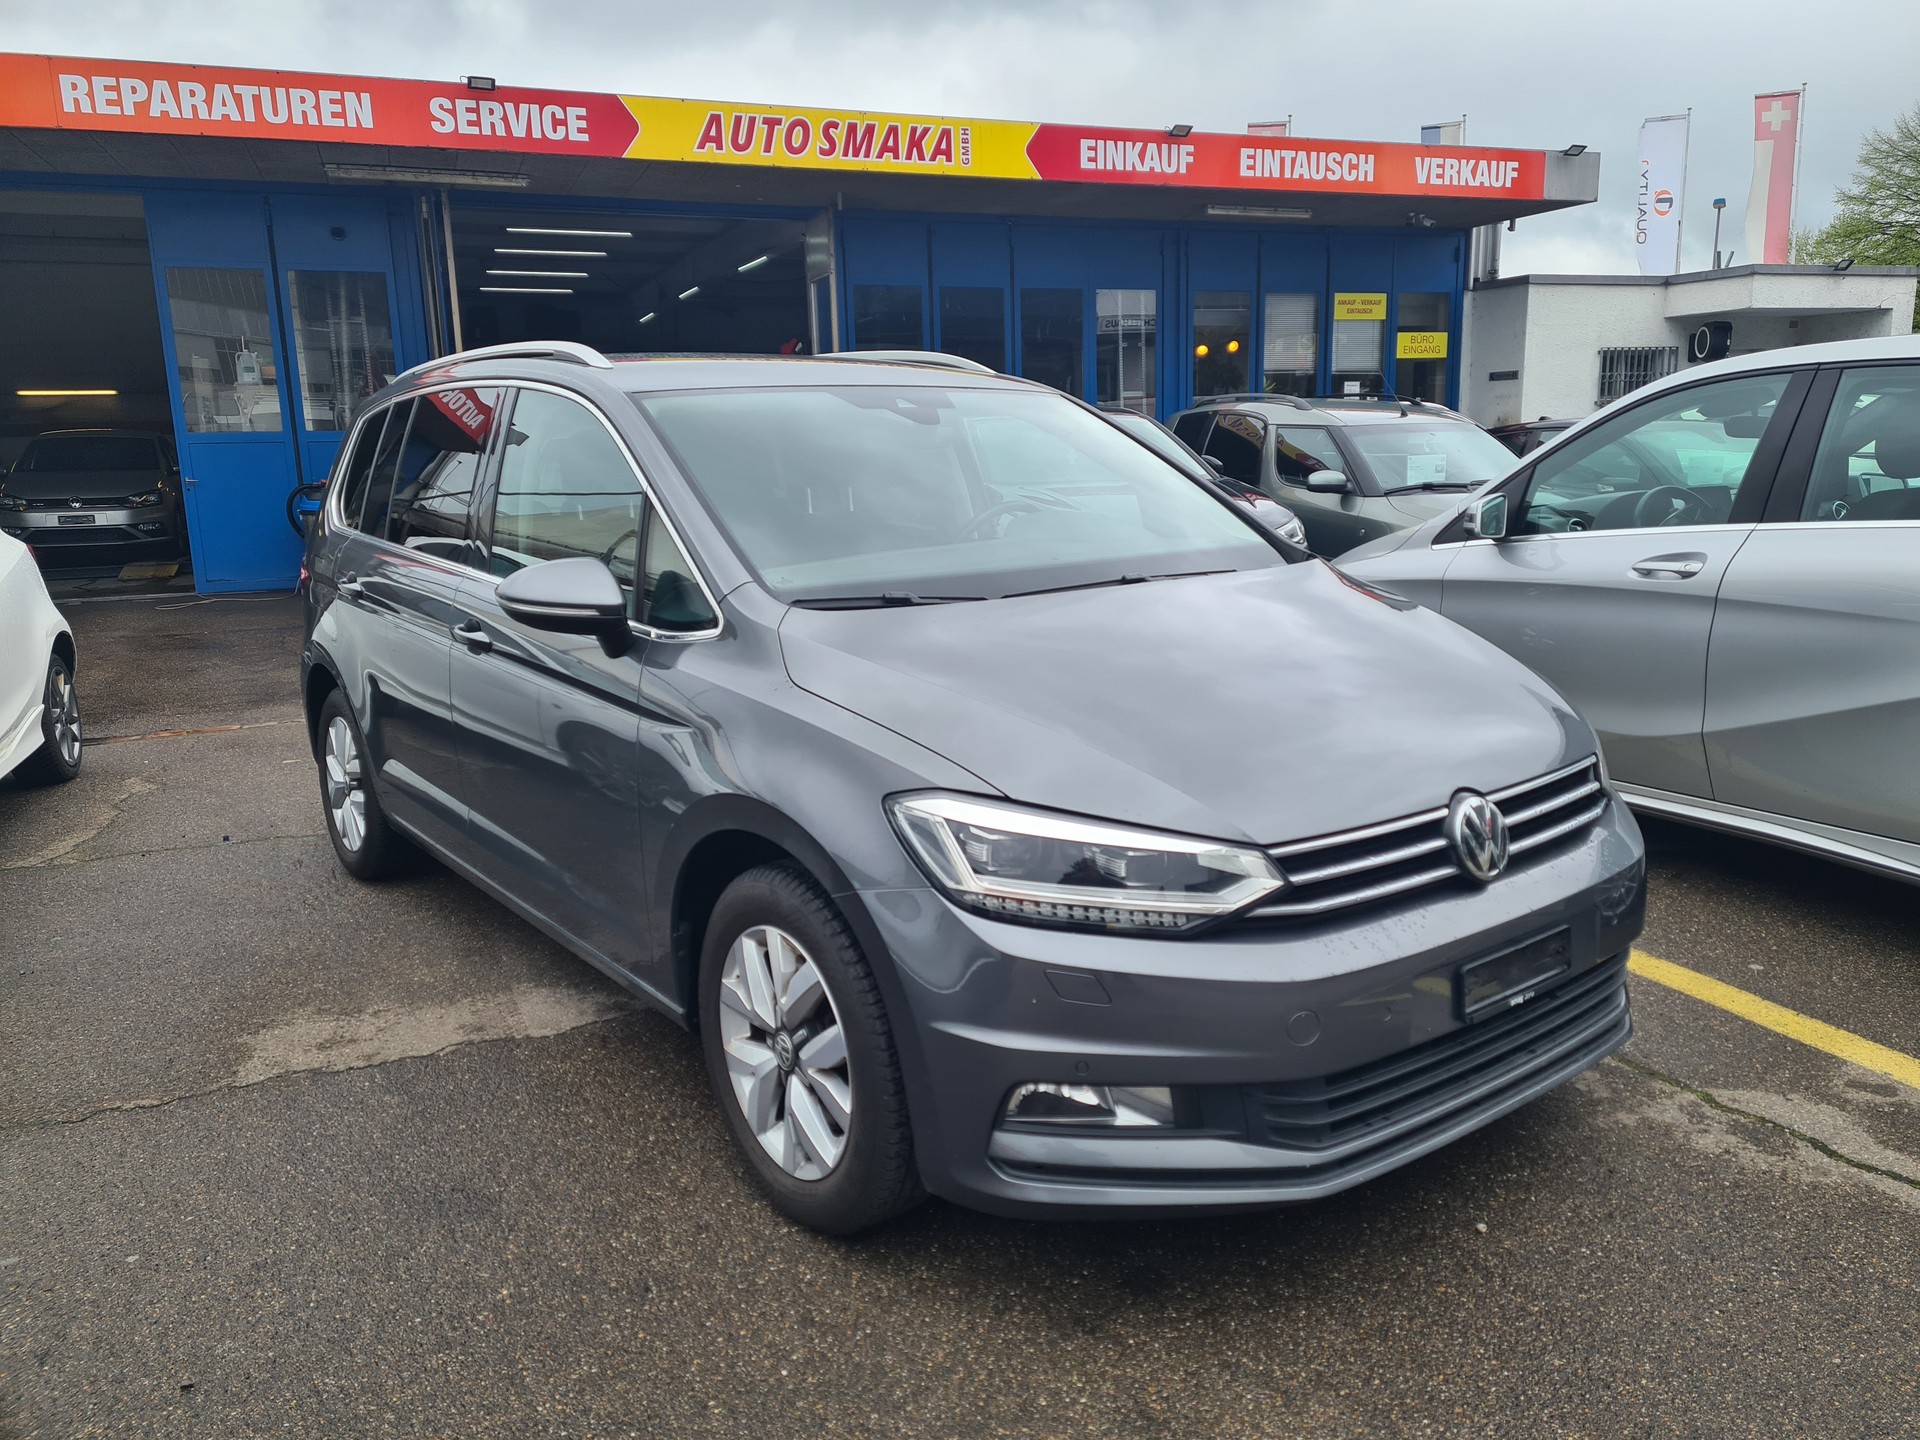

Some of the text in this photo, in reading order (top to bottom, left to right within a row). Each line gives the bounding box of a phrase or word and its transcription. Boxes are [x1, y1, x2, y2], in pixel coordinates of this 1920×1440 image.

[58, 73, 374, 129] REPARATUREN
[429, 96, 590, 142] SERVICE
[695, 110, 955, 166] AUTO SMAKA
[959, 126, 971, 167] GMBH
[1079, 138, 1195, 175] EINKAUF
[1239, 147, 1375, 182] EINTAUSCH
[1414, 156, 1519, 188] VERKAUF
[1346, 307, 1373, 315] EINTAUSCH
[1403, 345, 1441, 354] EINGANG
[1410, 333, 1435, 344] BÜRO
